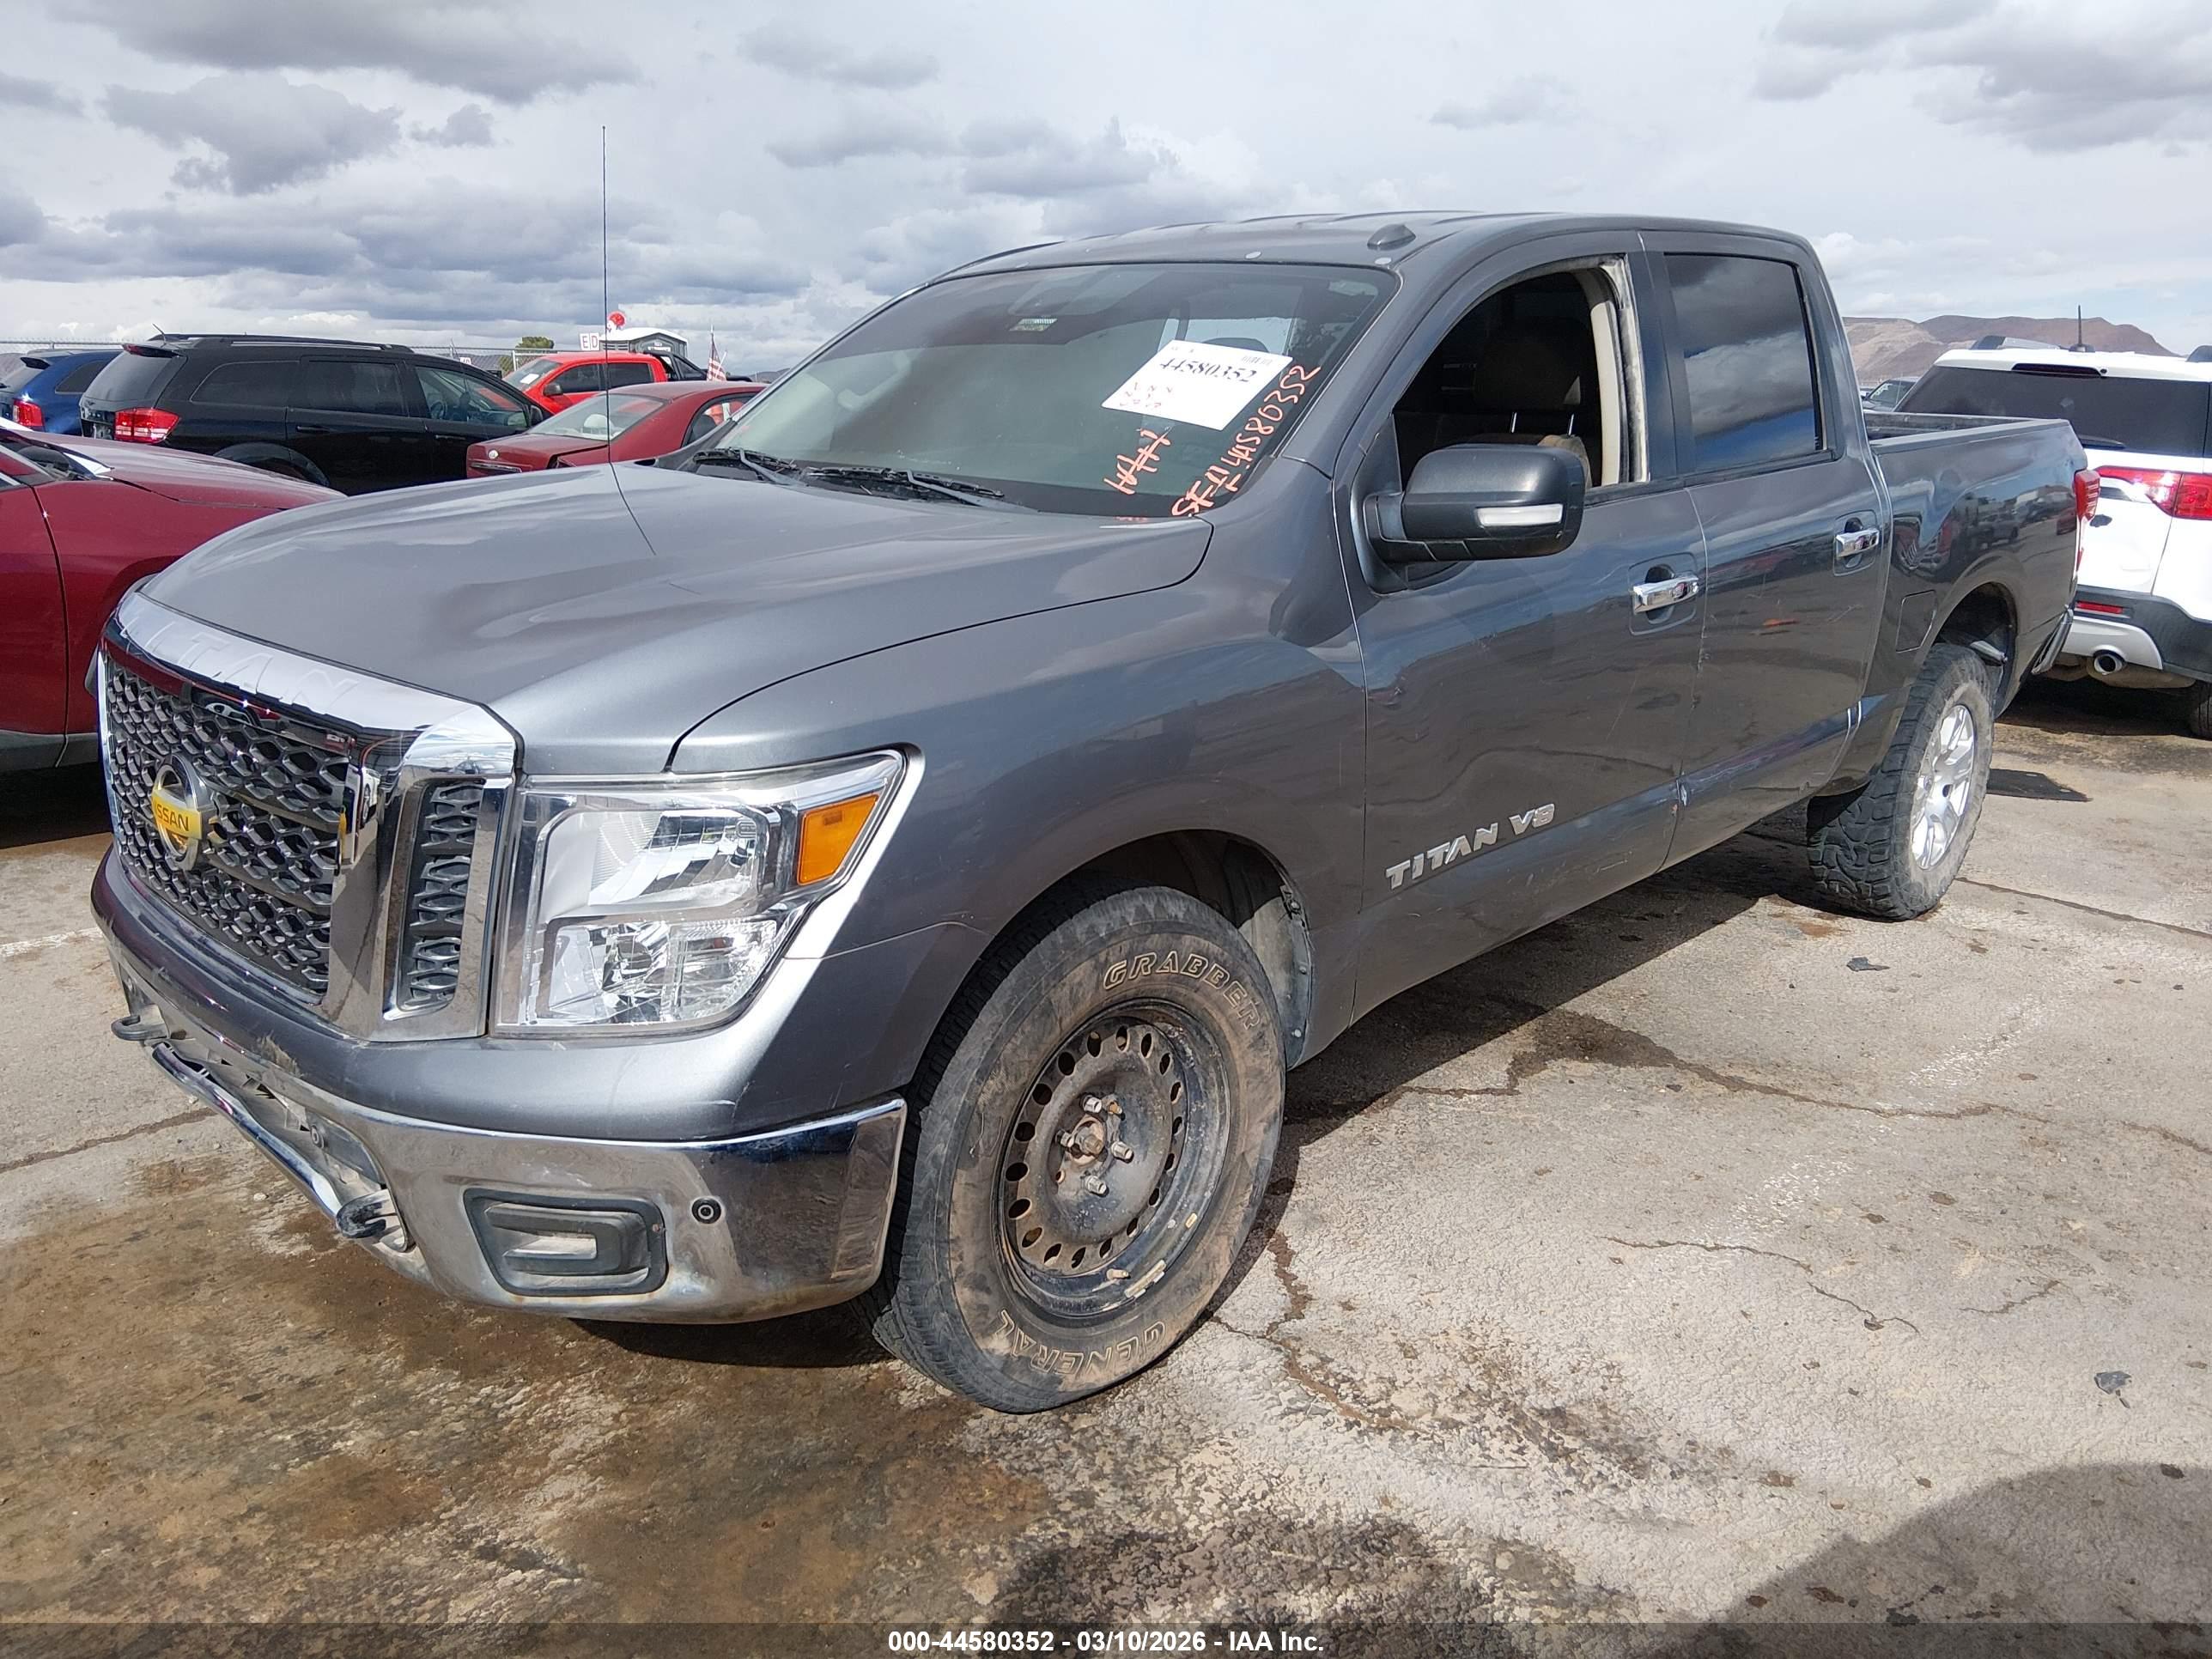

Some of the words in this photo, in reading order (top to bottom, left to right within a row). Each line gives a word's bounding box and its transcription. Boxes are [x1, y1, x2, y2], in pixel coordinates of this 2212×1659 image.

[1159, 357, 1257, 382] 44580352
[1385, 823, 1498, 890] TITAN
[1509, 803, 1555, 836] V8
[1103, 951, 1261, 1030] GRABBER
[989, 1309, 1167, 1376] GENERAL
